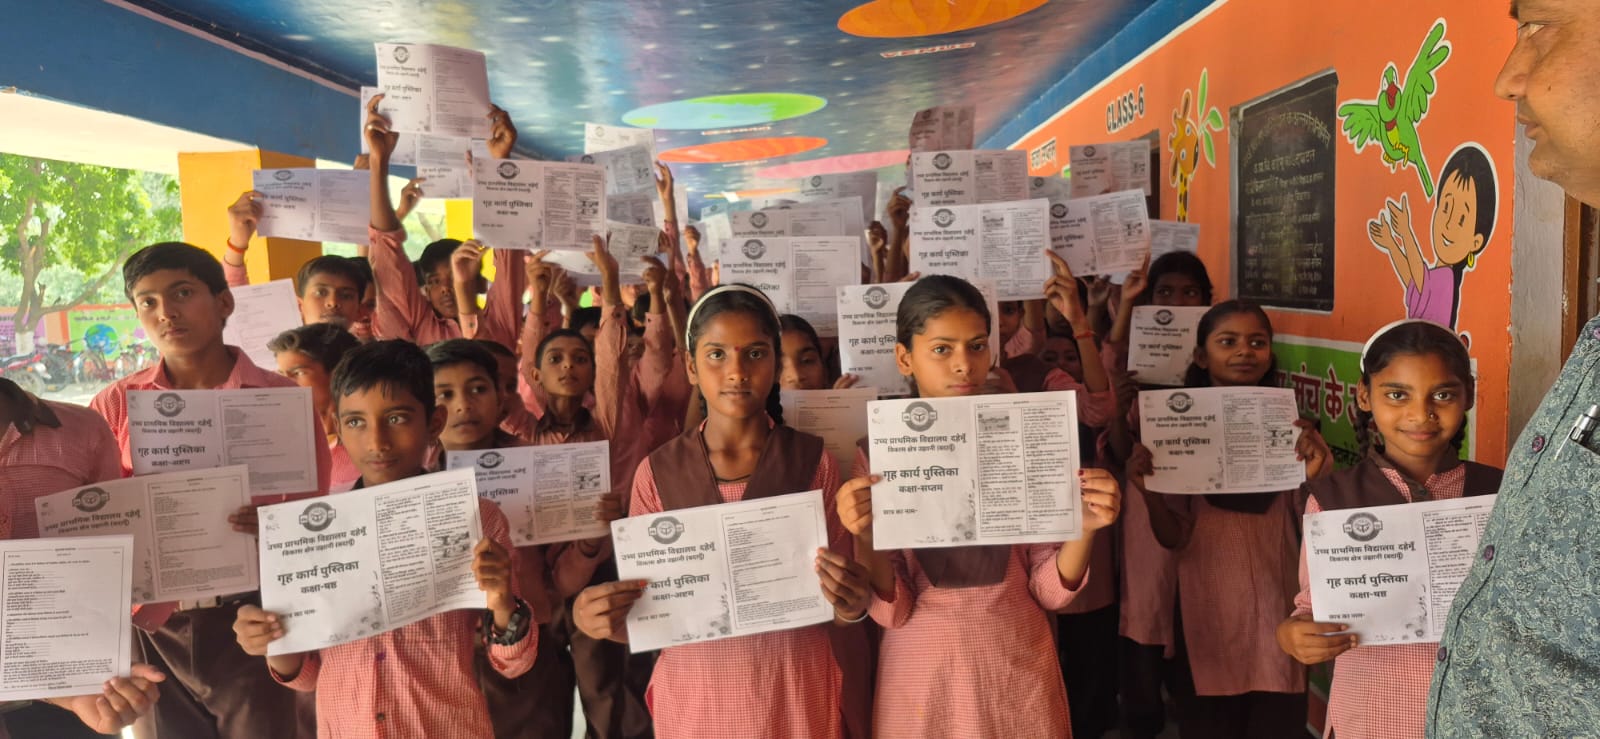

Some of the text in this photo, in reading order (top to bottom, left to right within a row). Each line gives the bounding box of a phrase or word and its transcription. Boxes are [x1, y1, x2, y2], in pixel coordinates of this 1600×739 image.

[1105, 85, 1144, 132] CLASS-6
[1292, 364, 1320, 414] मंच
[1324, 366, 1344, 420] के
[890, 436, 918, 444] प्राथमिक
[919, 434, 947, 443] विद्यालय
[138, 444, 206, 457] गृह कार्य पुस्तिका
[883, 465, 959, 482] गृह कार्य पुस्तिका
[898, 484, 943, 493] कक्षा-सप्तम
[285, 537, 316, 548] प्राथमिक
[317, 531, 347, 543] विद्यालय
[638, 549, 667, 558] प्राथमिक
[668, 546, 696, 554] विद्यालय
[1331, 545, 1362, 554] प्राथमिक
[1364, 543, 1395, 552] विद्यालय
[277, 561, 360, 586] गृह कार्य पुस्तिका
[1326, 573, 1408, 589] गृह कार्य पुस्तिका
[651, 577, 671, 589] कार्य
[674, 574, 710, 588] पुस्तिका
